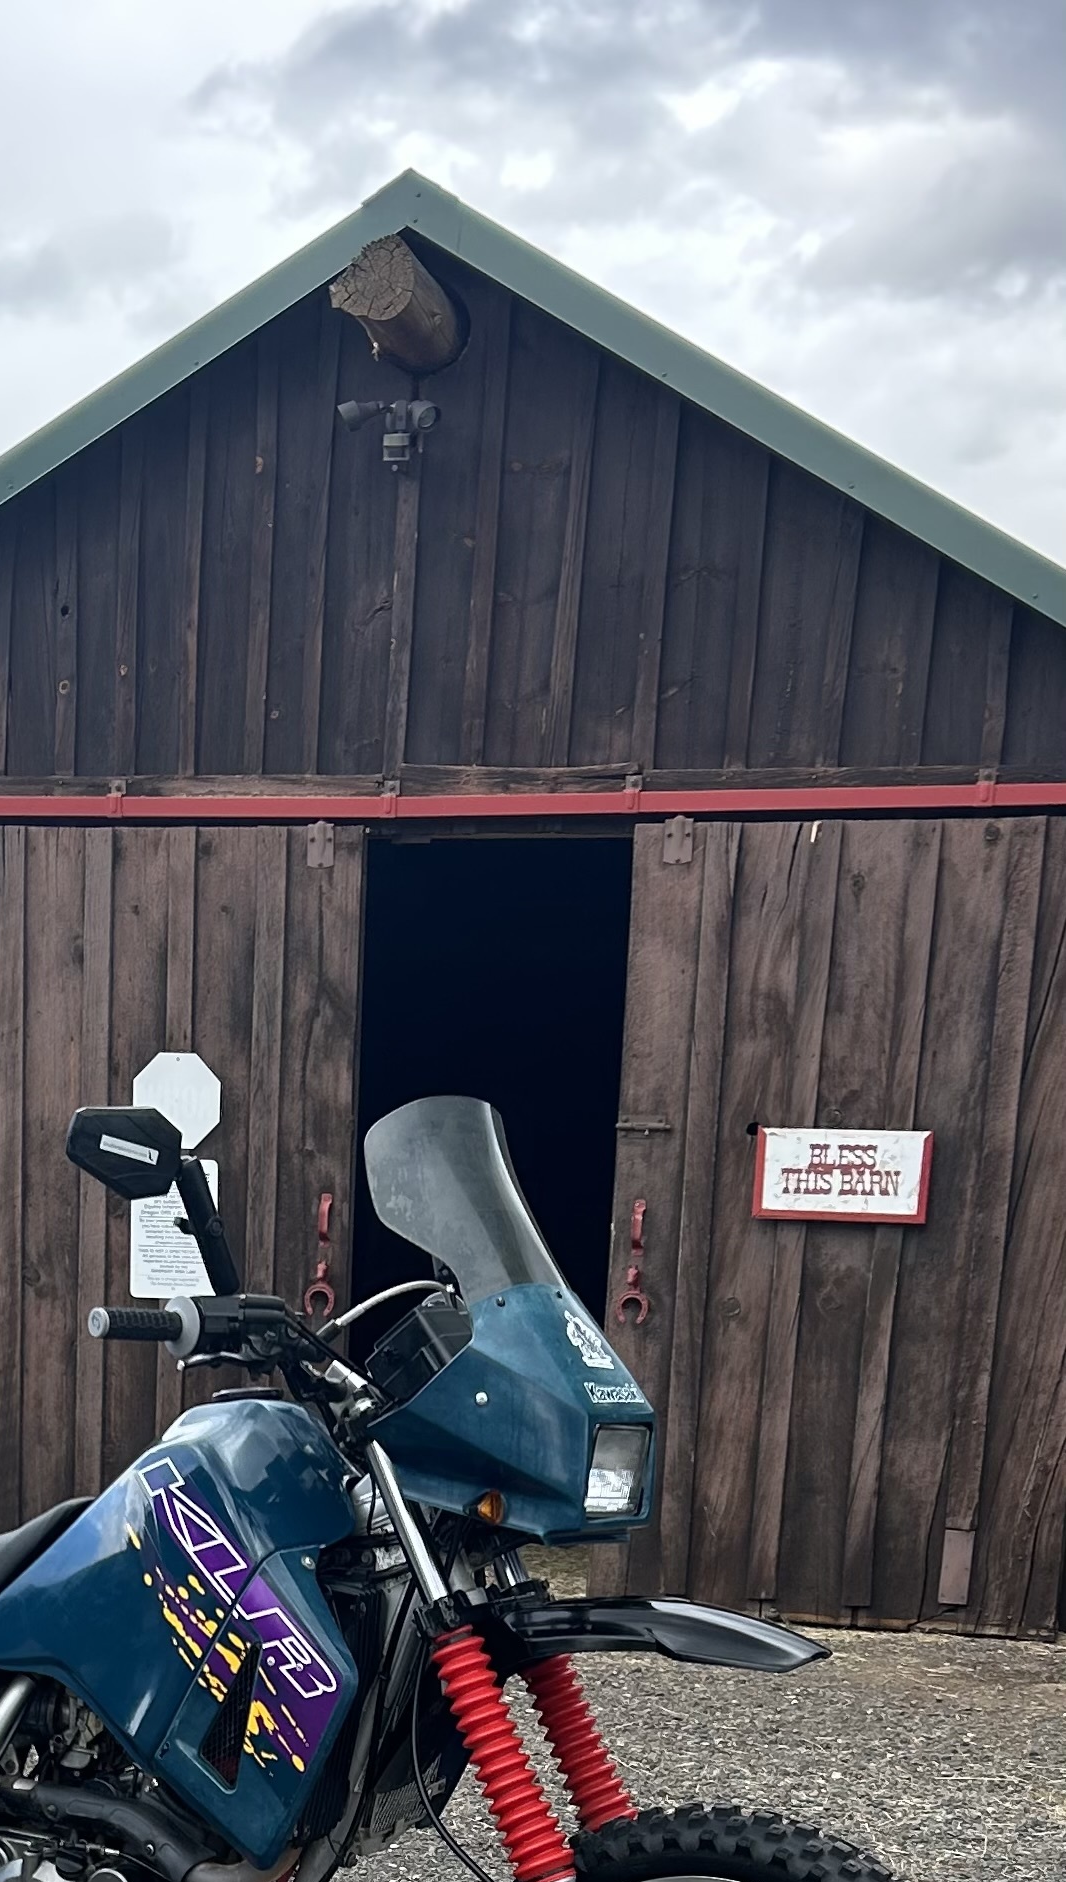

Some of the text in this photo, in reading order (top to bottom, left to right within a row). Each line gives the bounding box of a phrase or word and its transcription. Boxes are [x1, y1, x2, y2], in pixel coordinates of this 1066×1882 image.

[808, 1143, 878, 1170] BLESS
[781, 1168, 901, 1196] THIS BARN
